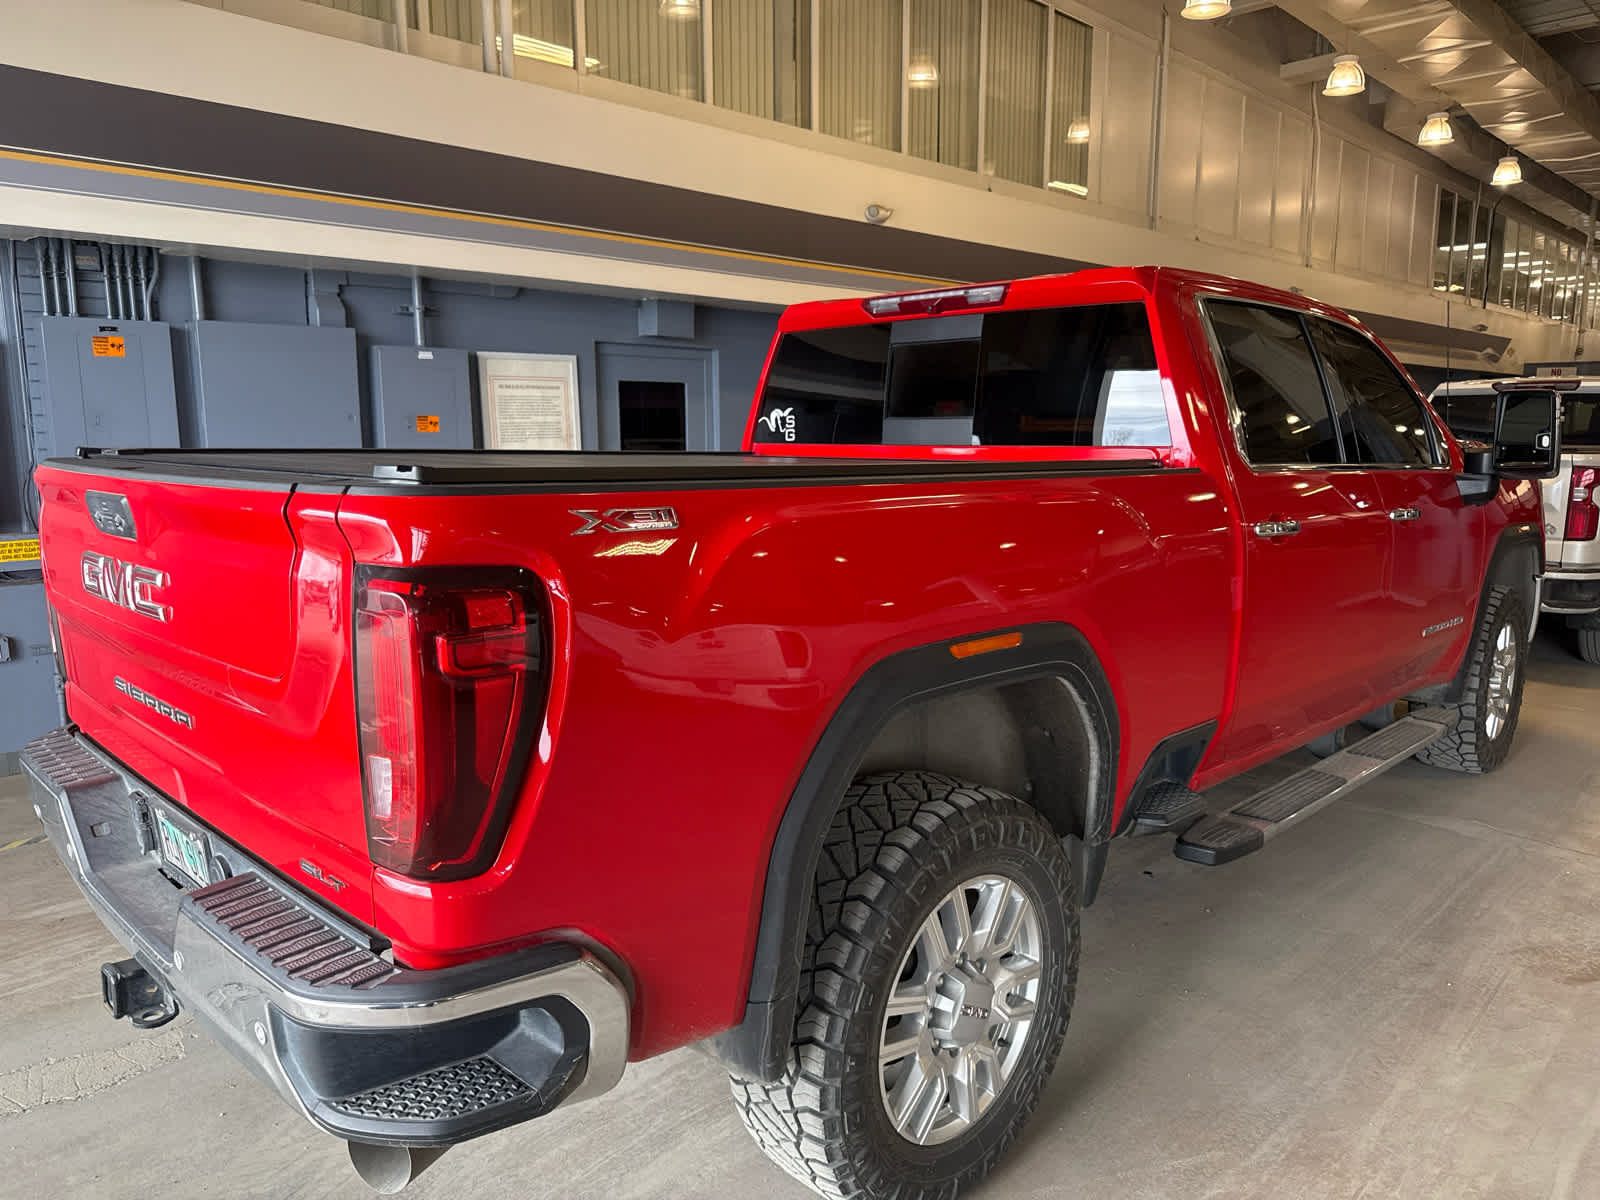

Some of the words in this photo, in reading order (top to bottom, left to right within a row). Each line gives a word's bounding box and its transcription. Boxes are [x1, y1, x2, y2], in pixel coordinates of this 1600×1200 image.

[1551, 367, 1562, 377] NO
[568, 506, 680, 535] X31
[81, 550, 173, 623] GMC
[113, 675, 193, 730] SIERRA
[300, 858, 348, 892] SLT
